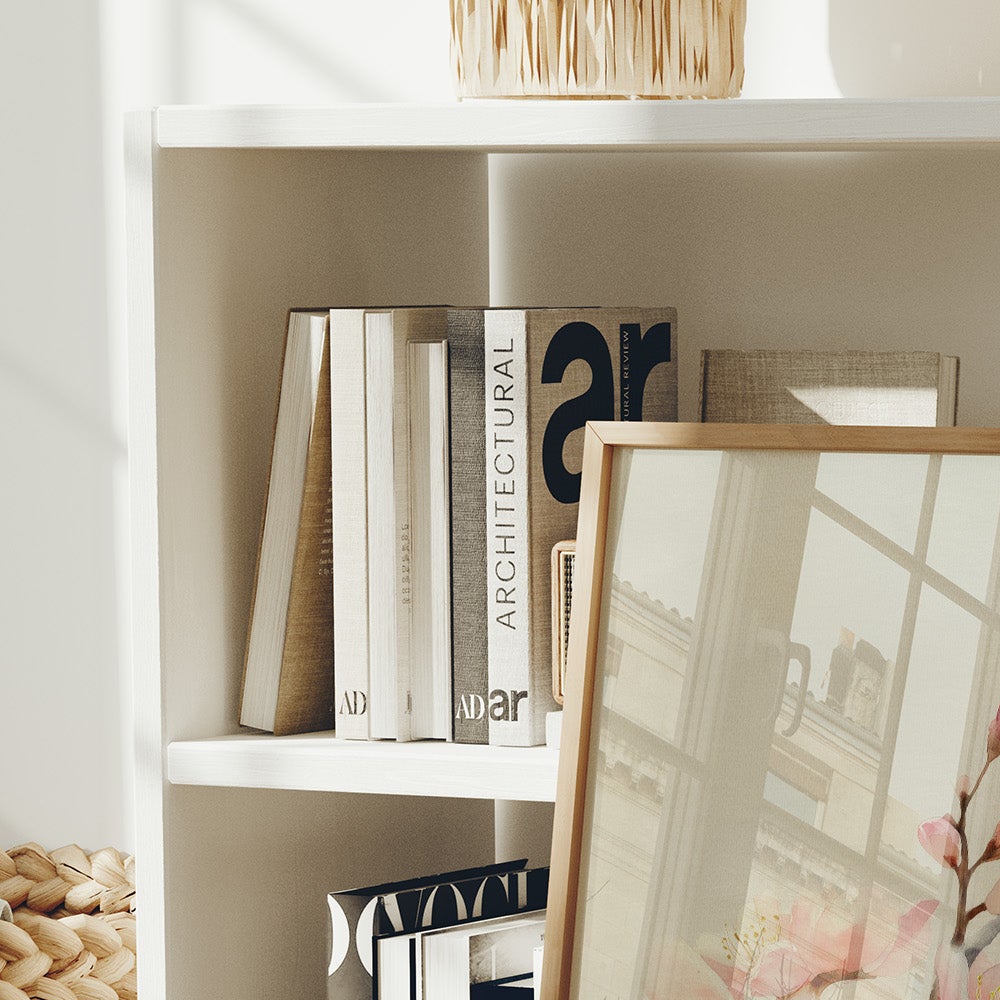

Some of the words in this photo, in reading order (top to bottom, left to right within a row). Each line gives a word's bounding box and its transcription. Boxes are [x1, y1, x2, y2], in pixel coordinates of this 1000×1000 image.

[541, 322, 671, 504] ar
[493, 338, 516, 630] ARCHITECTURAL
[339, 690, 367, 715] AD
[455, 694, 486, 720] AD
[489, 689, 528, 721] ar
